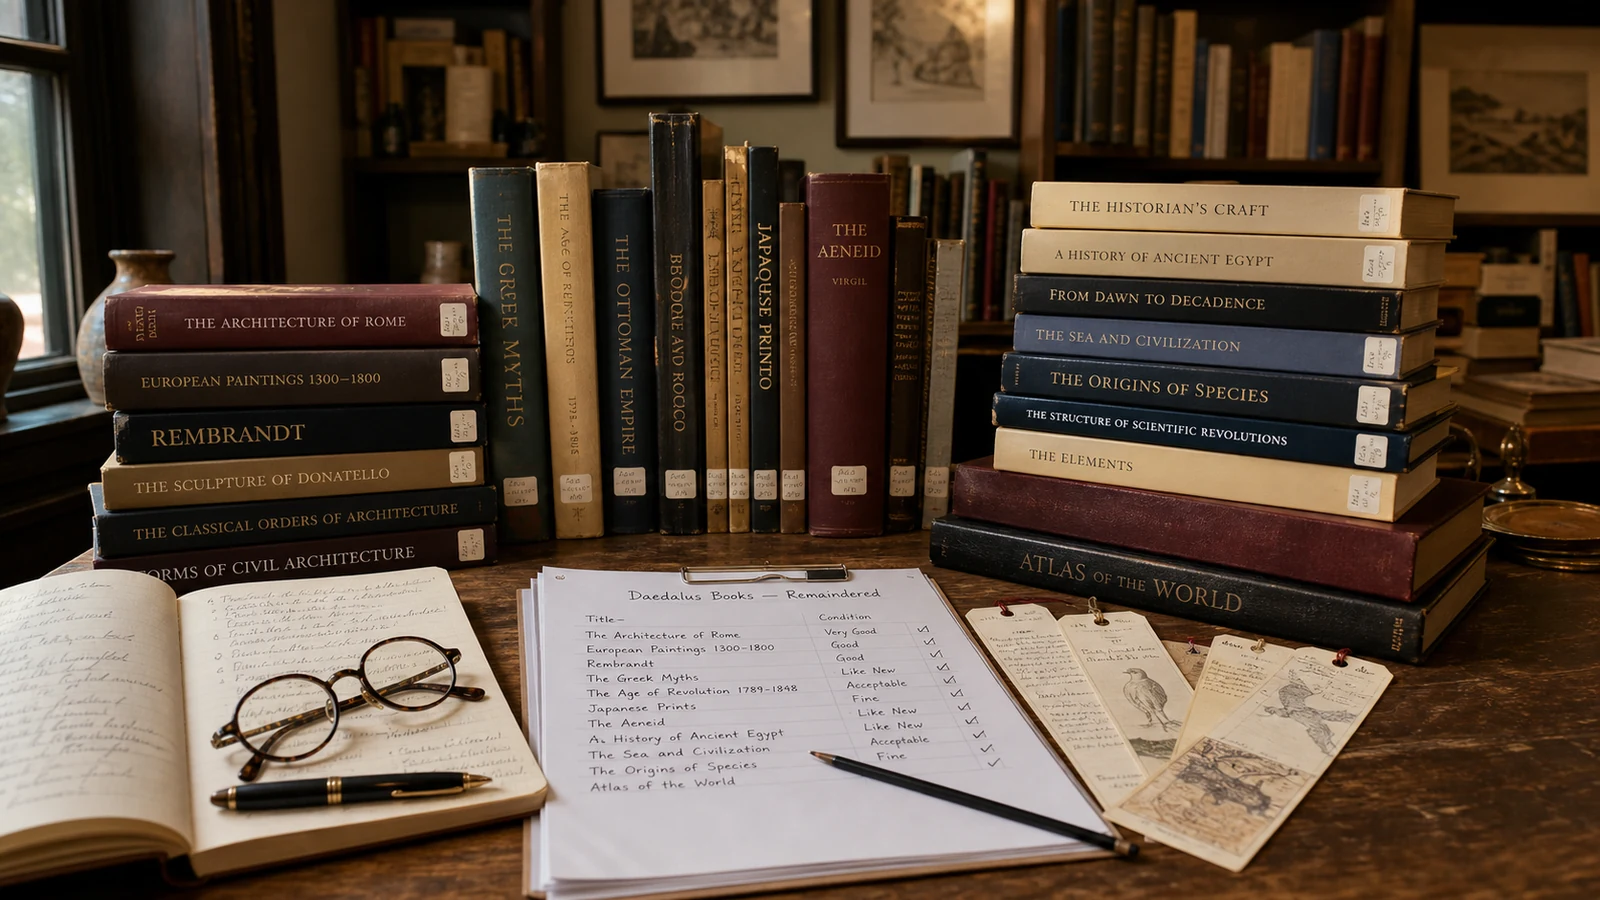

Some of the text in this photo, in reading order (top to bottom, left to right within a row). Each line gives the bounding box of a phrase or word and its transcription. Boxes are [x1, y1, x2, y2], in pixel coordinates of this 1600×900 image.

[560, 194, 569, 221] THE
[1070, 201, 1269, 217] THE HISTORIAN'S CRAFT
[497, 215, 513, 252] THE
[832, 224, 867, 237] THE
[616, 235, 630, 272] THE
[817, 245, 881, 258] AENEID
[1054, 250, 1274, 268] A HISTORY OF ANCIENT EGYPT
[562, 261, 572, 278] OF
[832, 278, 867, 286] VIRGIL
[1049, 289, 1265, 311] FROM DAWN TO DECADENCE
[184, 316, 406, 330] THE ARCHITECTURE OF ROME
[616, 283, 634, 380] OTTOMAN
[1035, 329, 1241, 353] THE SEA AND CIVILIZATION
[141, 375, 221, 389] EUROPEAN
[226, 374, 304, 387] PAINTINGS
[503, 340, 524, 427] MYTHS
[1050, 371, 1269, 404] THE ORIGINS OF SPECIES
[620, 388, 636, 455] EMPIRE
[1026, 409, 1288, 446] THE STRUCTURE OF SCIENTIFIC REVOLUTIONS
[151, 424, 306, 447] REMBRANDT
[1029, 448, 1134, 473] THE ELEMENTS
[134, 468, 390, 494] THE SCULPTURE OF DONATELLO
[133, 503, 459, 541] THE CLASSICAL ORDERS OF ARCHITECTURE
[140, 546, 415, 581] ORMS OF CIVIL ARCHITECTURE
[1019, 552, 1243, 612] ATLAS OF THE WORLD
[628, 590, 702, 601] Daedalus
[711, 590, 753, 600] Books
[786, 588, 881, 599] Remaindered
[818, 613, 872, 621] Condition
[585, 630, 741, 640] The Architecture of Rome
[824, 628, 848, 637] Very
[586, 645, 643, 657] European
[651, 645, 706, 656] Paintings
[831, 641, 859, 649] Good
[587, 659, 654, 668] Rembrandt
[836, 654, 864, 662] Good
[586, 673, 699, 685] The Greek Myths
[846, 680, 907, 690] Acceptable
[587, 689, 609, 698] The
[618, 689, 640, 700] Age
[647, 688, 660, 697] of
[668, 687, 730, 696] Revolution
[852, 695, 880, 703] Fine
[588, 703, 697, 715] Japanese Prints
[858, 707, 917, 717] Like New
[588, 718, 666, 728] The Aeneid
[864, 722, 923, 731] Like New
[614, 734, 661, 746] History
[669, 733, 682, 741] of
[690, 731, 739, 741] Ancient
[747, 729, 785, 741] Egypt
[870, 736, 930, 748] Acceptable
[588, 746, 771, 760] The Sea and Civilization
[877, 752, 907, 761] Fine
[589, 761, 758, 777] The Origins of Species
[590, 777, 736, 792] Atlas of the World
